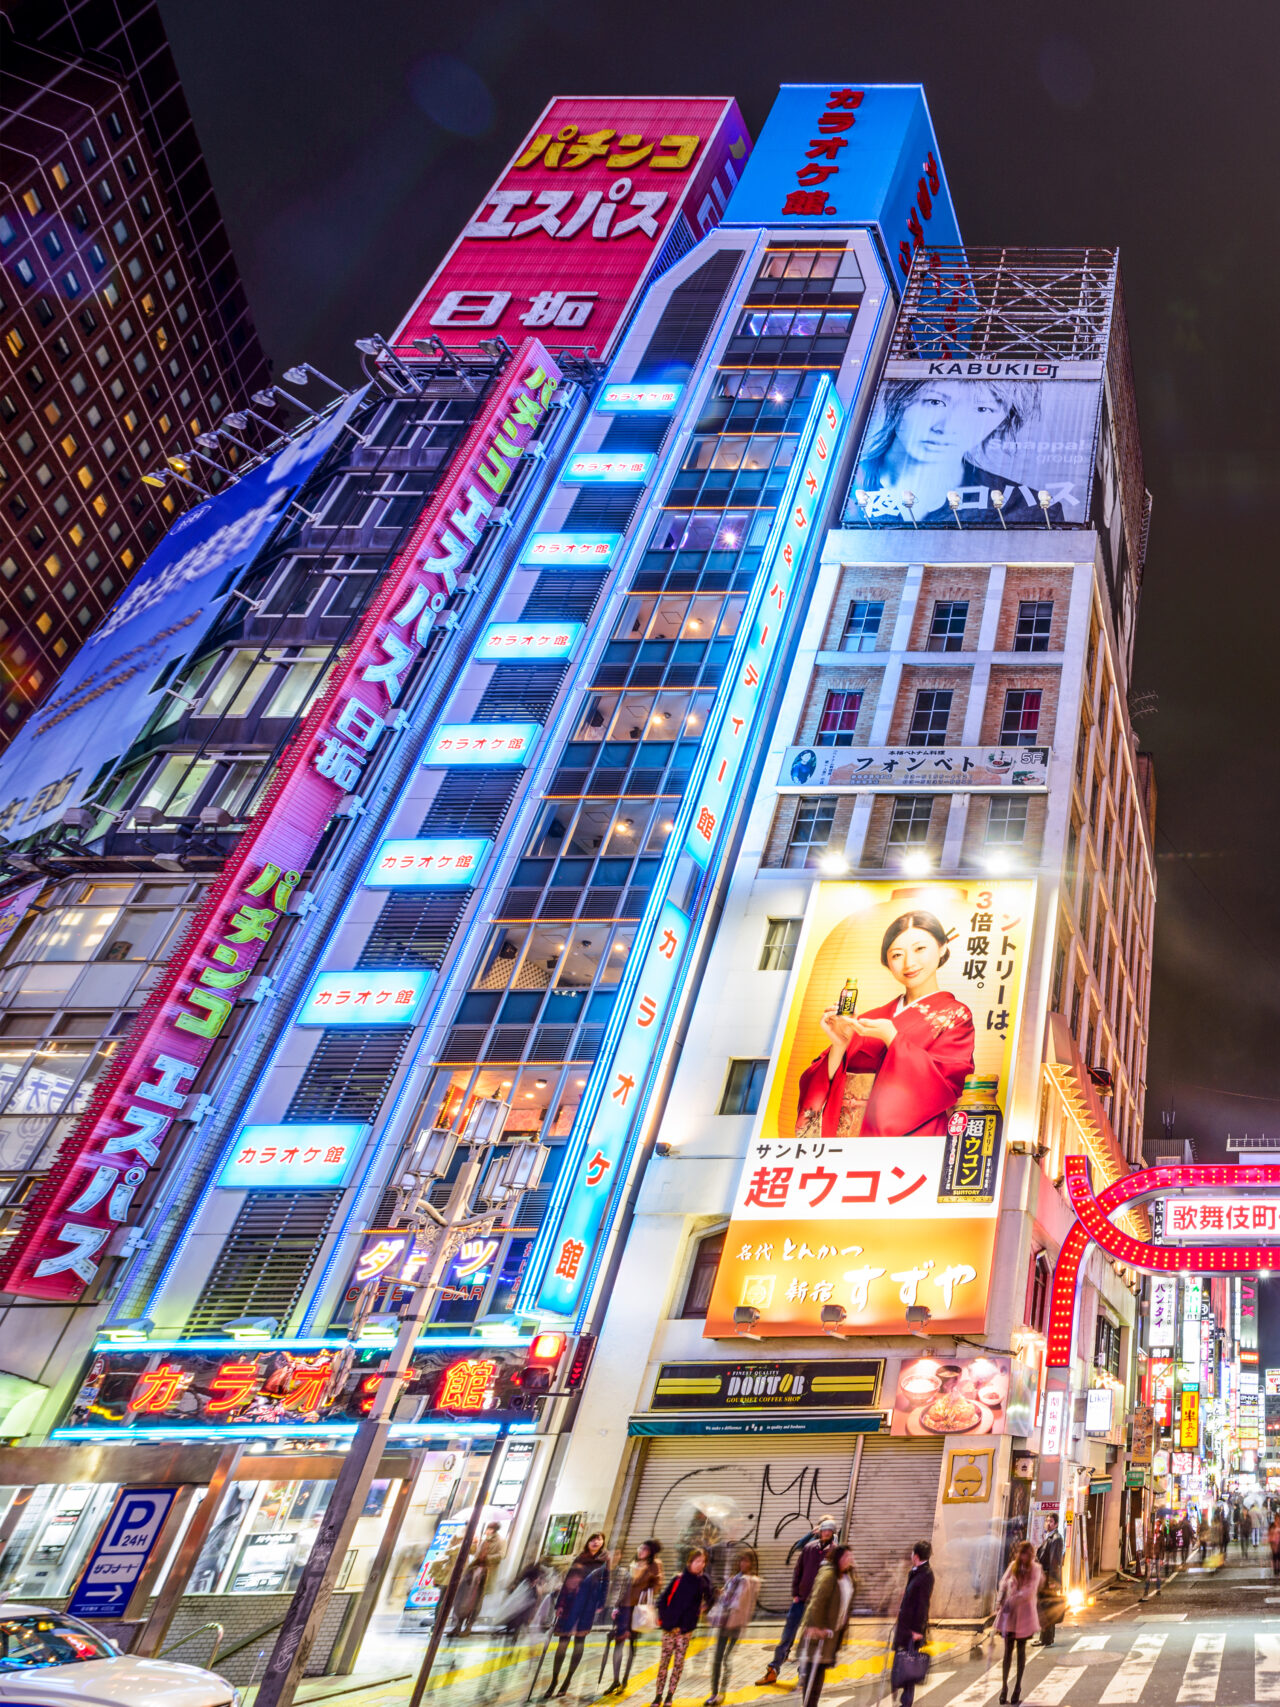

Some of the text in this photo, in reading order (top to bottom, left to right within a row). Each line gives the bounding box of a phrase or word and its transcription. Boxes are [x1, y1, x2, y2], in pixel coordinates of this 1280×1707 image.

[513, 123, 701, 170] パチンコ
[782, 87, 866, 217] カラオケ館
[464, 178, 669, 239] エスパス
[428, 290, 600, 329] 日拓
[605, 390, 677, 403] カラオケ館
[571, 460, 646, 475] カラオケ館
[532, 542, 613, 556] カラオケ館
[361, 485, 491, 708] エスパス
[487, 633, 571, 648] カラオケ館
[436, 735, 525, 751] カラオケ館
[855, 755, 977, 774] フォンベト
[1020, 752, 1043, 765] 5F
[380, 853, 475, 870] カラオケ館
[189, 860, 301, 1040] パチンコ
[314, 988, 416, 1007] カラオケ館
[555, 928, 679, 1282] カラオケ館
[236, 1145, 347, 1165] カラオケ館
[756, 1142, 844, 1160] サントリー
[960, 1119, 986, 1186] 超ウコン
[34, 1051, 198, 1286] エスパス
[744, 1165, 929, 1209] 超ウコン
[780, 1236, 865, 1262] とんかつ
[441, 1285, 485, 1301] BAR
[783, 1257, 979, 1312] 新宿 すずや
[726, 1372, 806, 1397] DOUTOR
[108, 1499, 156, 1548] P
[120, 1534, 148, 1547] 24H
[92, 1562, 140, 1576] サブナード
